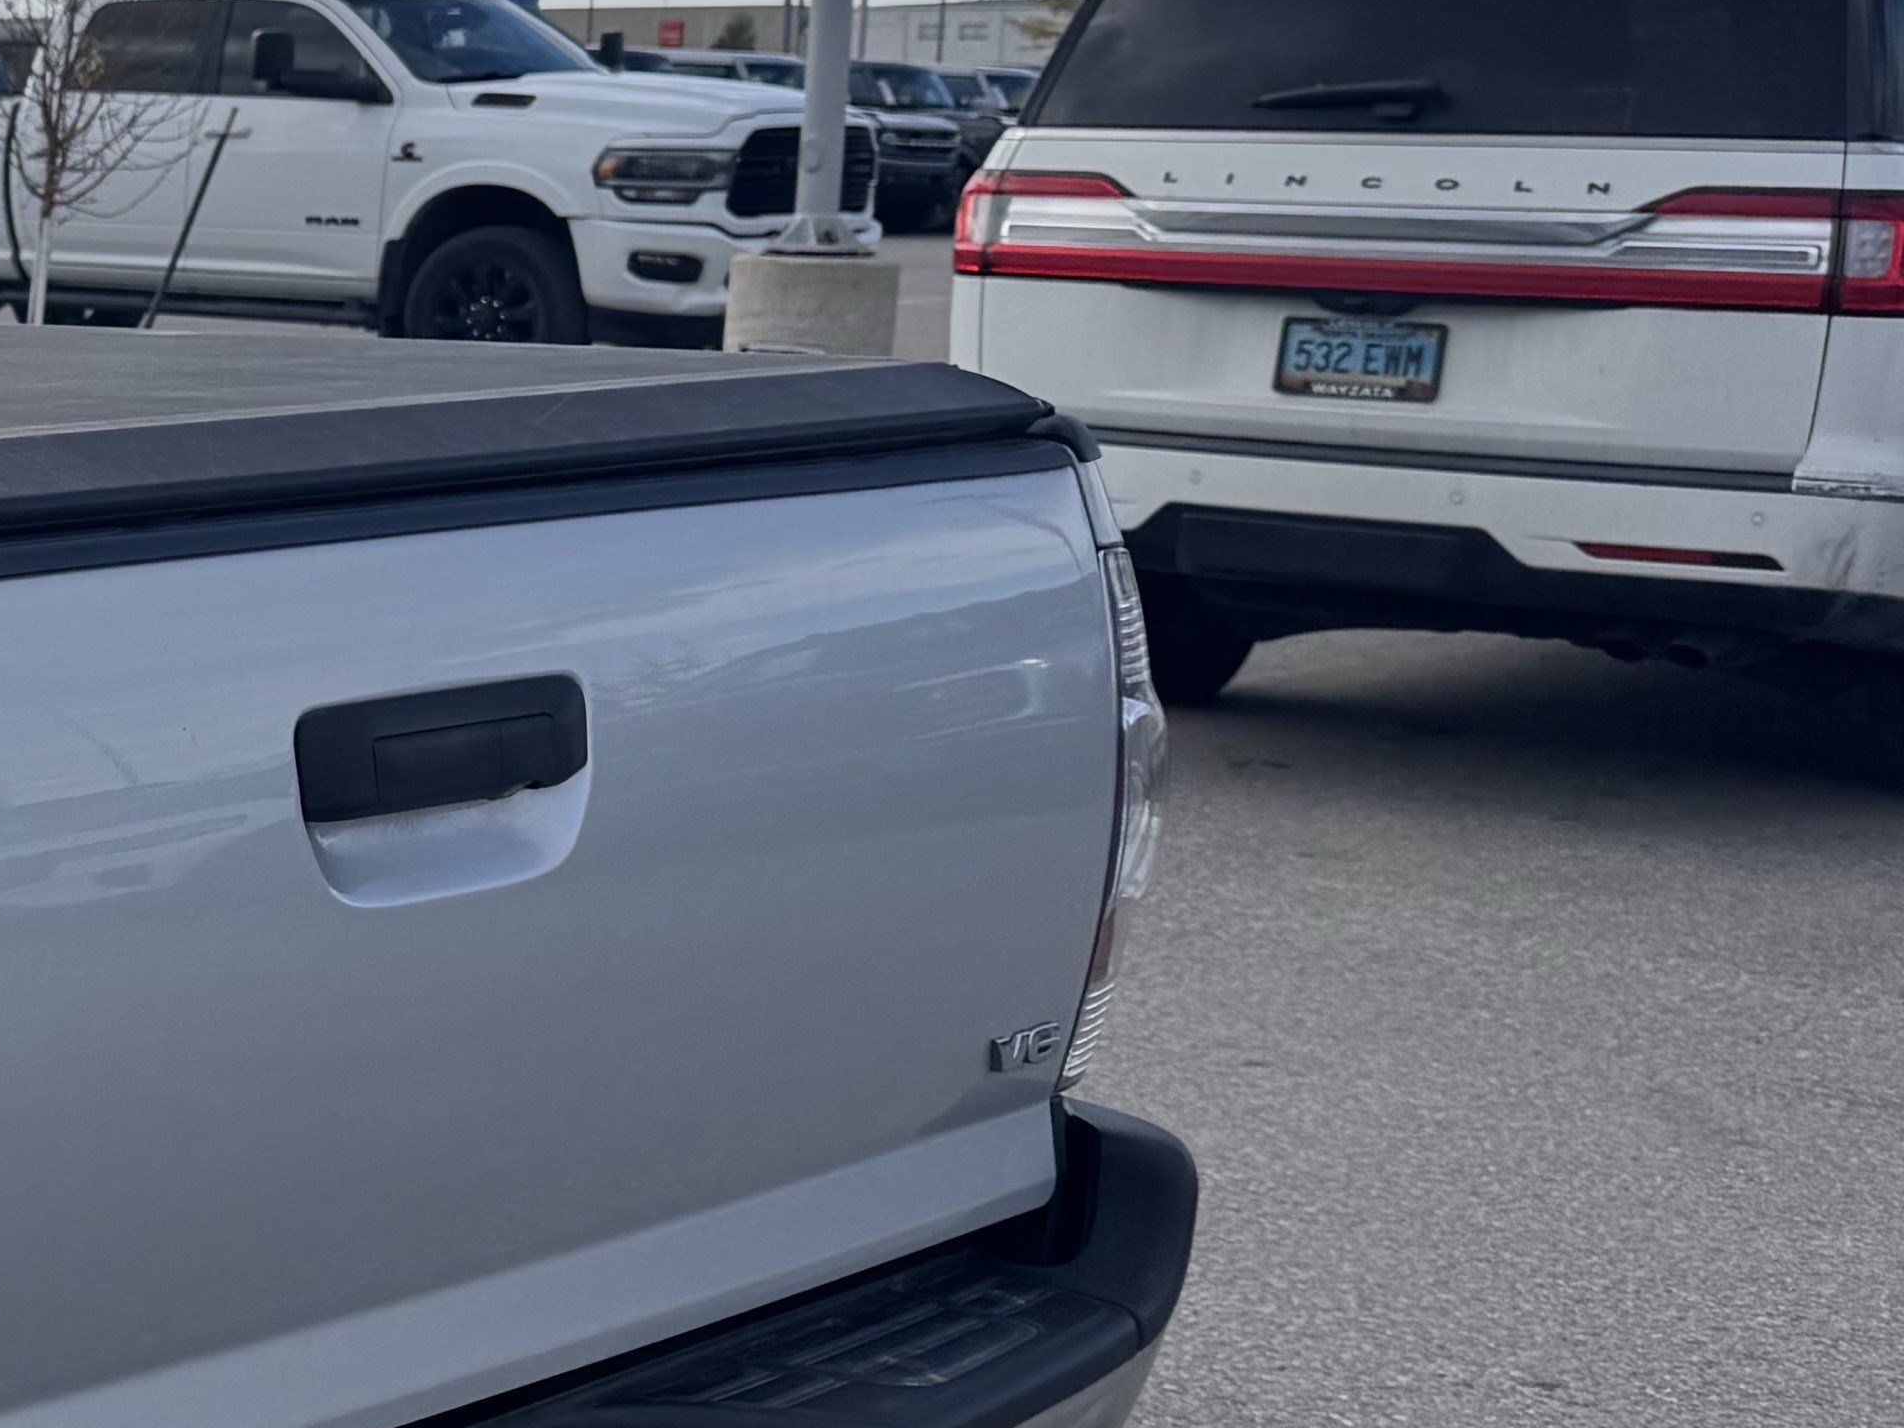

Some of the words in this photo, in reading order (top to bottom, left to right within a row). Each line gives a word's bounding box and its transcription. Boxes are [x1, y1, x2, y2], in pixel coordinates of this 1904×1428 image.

[1163, 171, 1611, 195] LINCOLN
[305, 215, 360, 226] RAM
[1292, 338, 1354, 374] 532
[1310, 382, 1395, 398] WAYZATA
[989, 1021, 1062, 1072] V6
